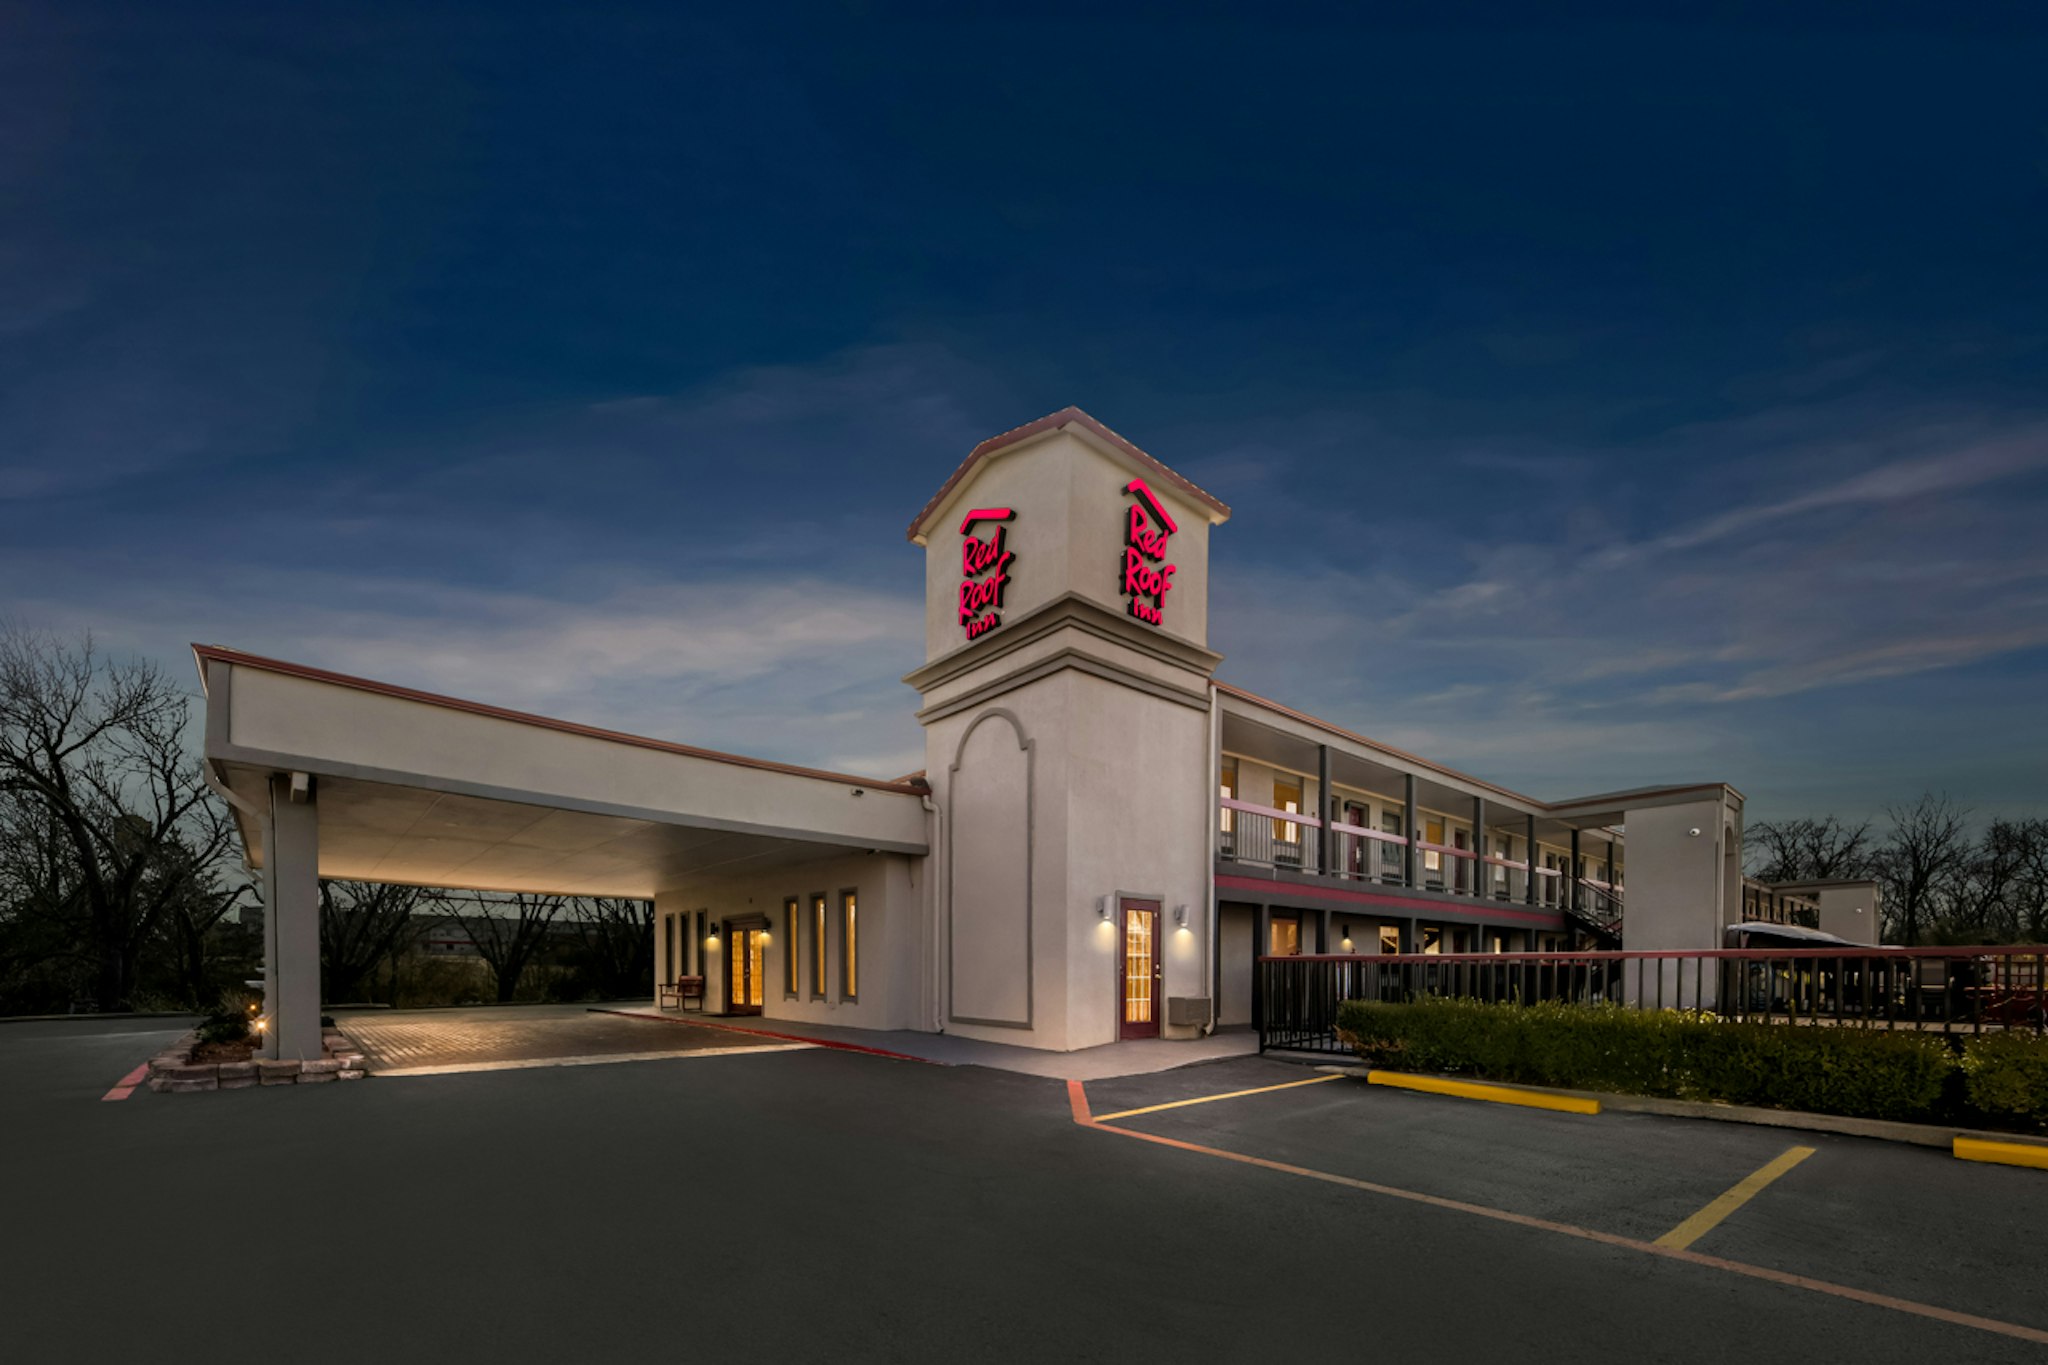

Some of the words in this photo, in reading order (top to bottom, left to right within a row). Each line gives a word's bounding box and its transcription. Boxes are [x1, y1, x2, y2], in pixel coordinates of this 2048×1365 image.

[963, 525, 1001, 575] Red
[1130, 504, 1169, 560] Red
[959, 551, 1010, 625] Roof
[1125, 548, 1176, 608] Roof
[966, 612, 996, 640] Inn
[1133, 597, 1163, 625] Inn
